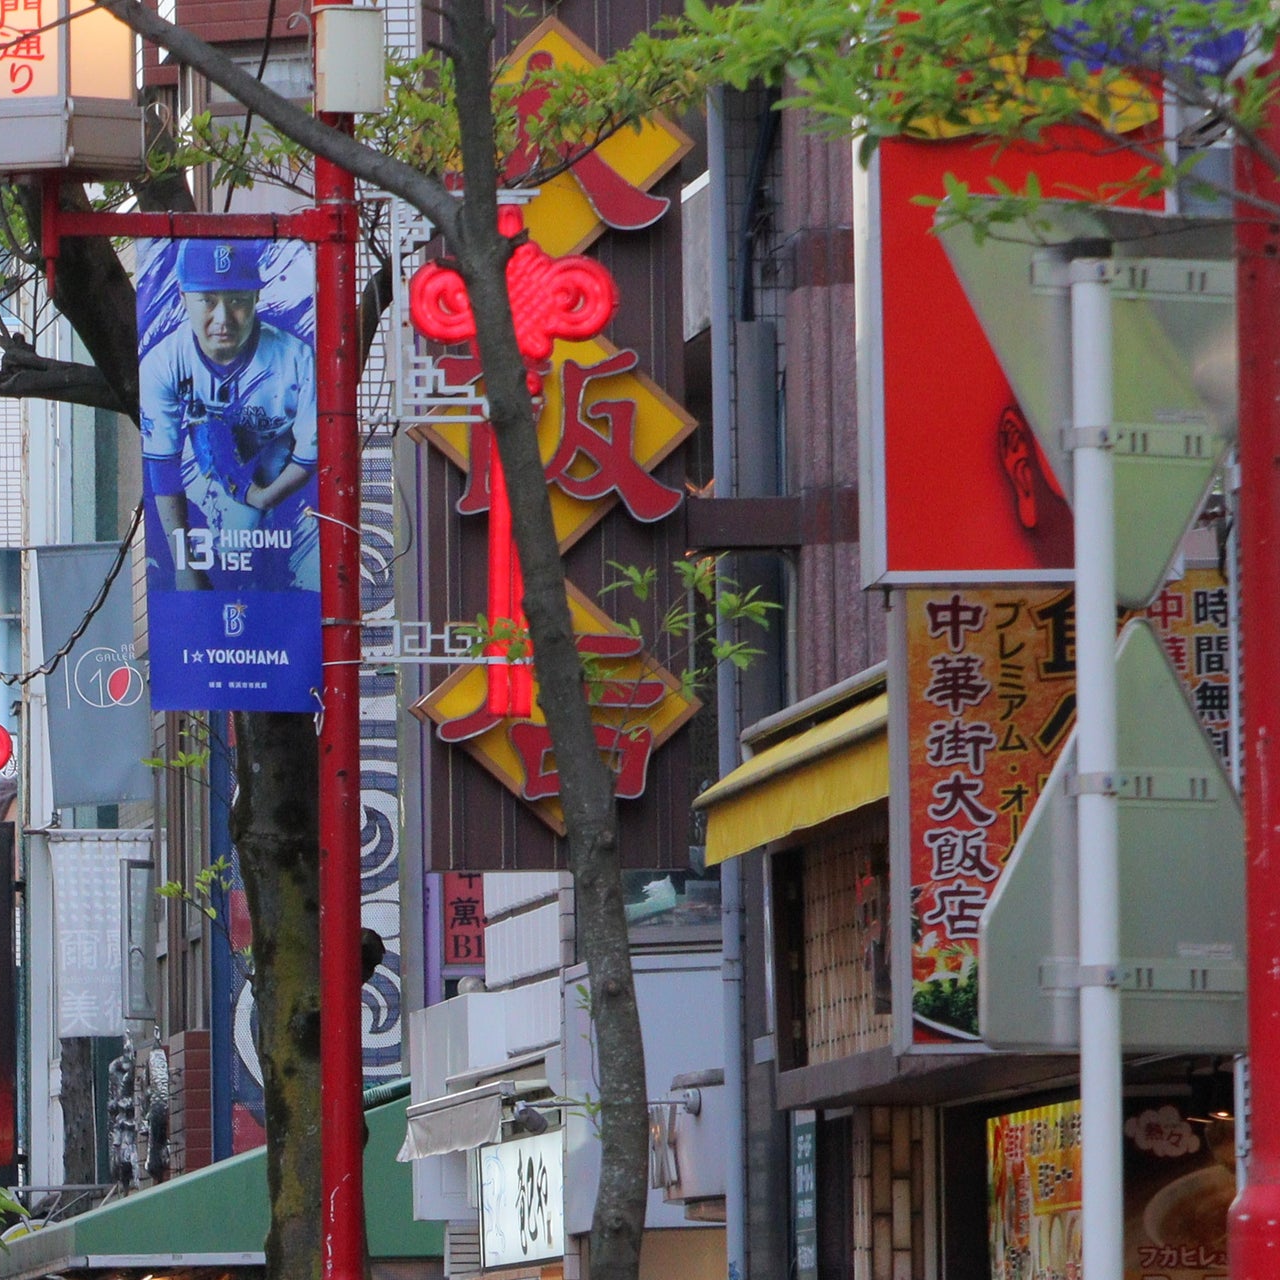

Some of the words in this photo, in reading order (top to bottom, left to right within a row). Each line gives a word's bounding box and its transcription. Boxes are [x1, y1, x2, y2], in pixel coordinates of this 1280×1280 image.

[171, 527, 215, 571] 13
[220, 529, 292, 549] HIROMU
[220, 552, 253, 572] ISE
[205, 648, 290, 665] YOKOHAMA
[924, 594, 998, 941] 中華街大飯店
[453, 934, 484, 958] B1
